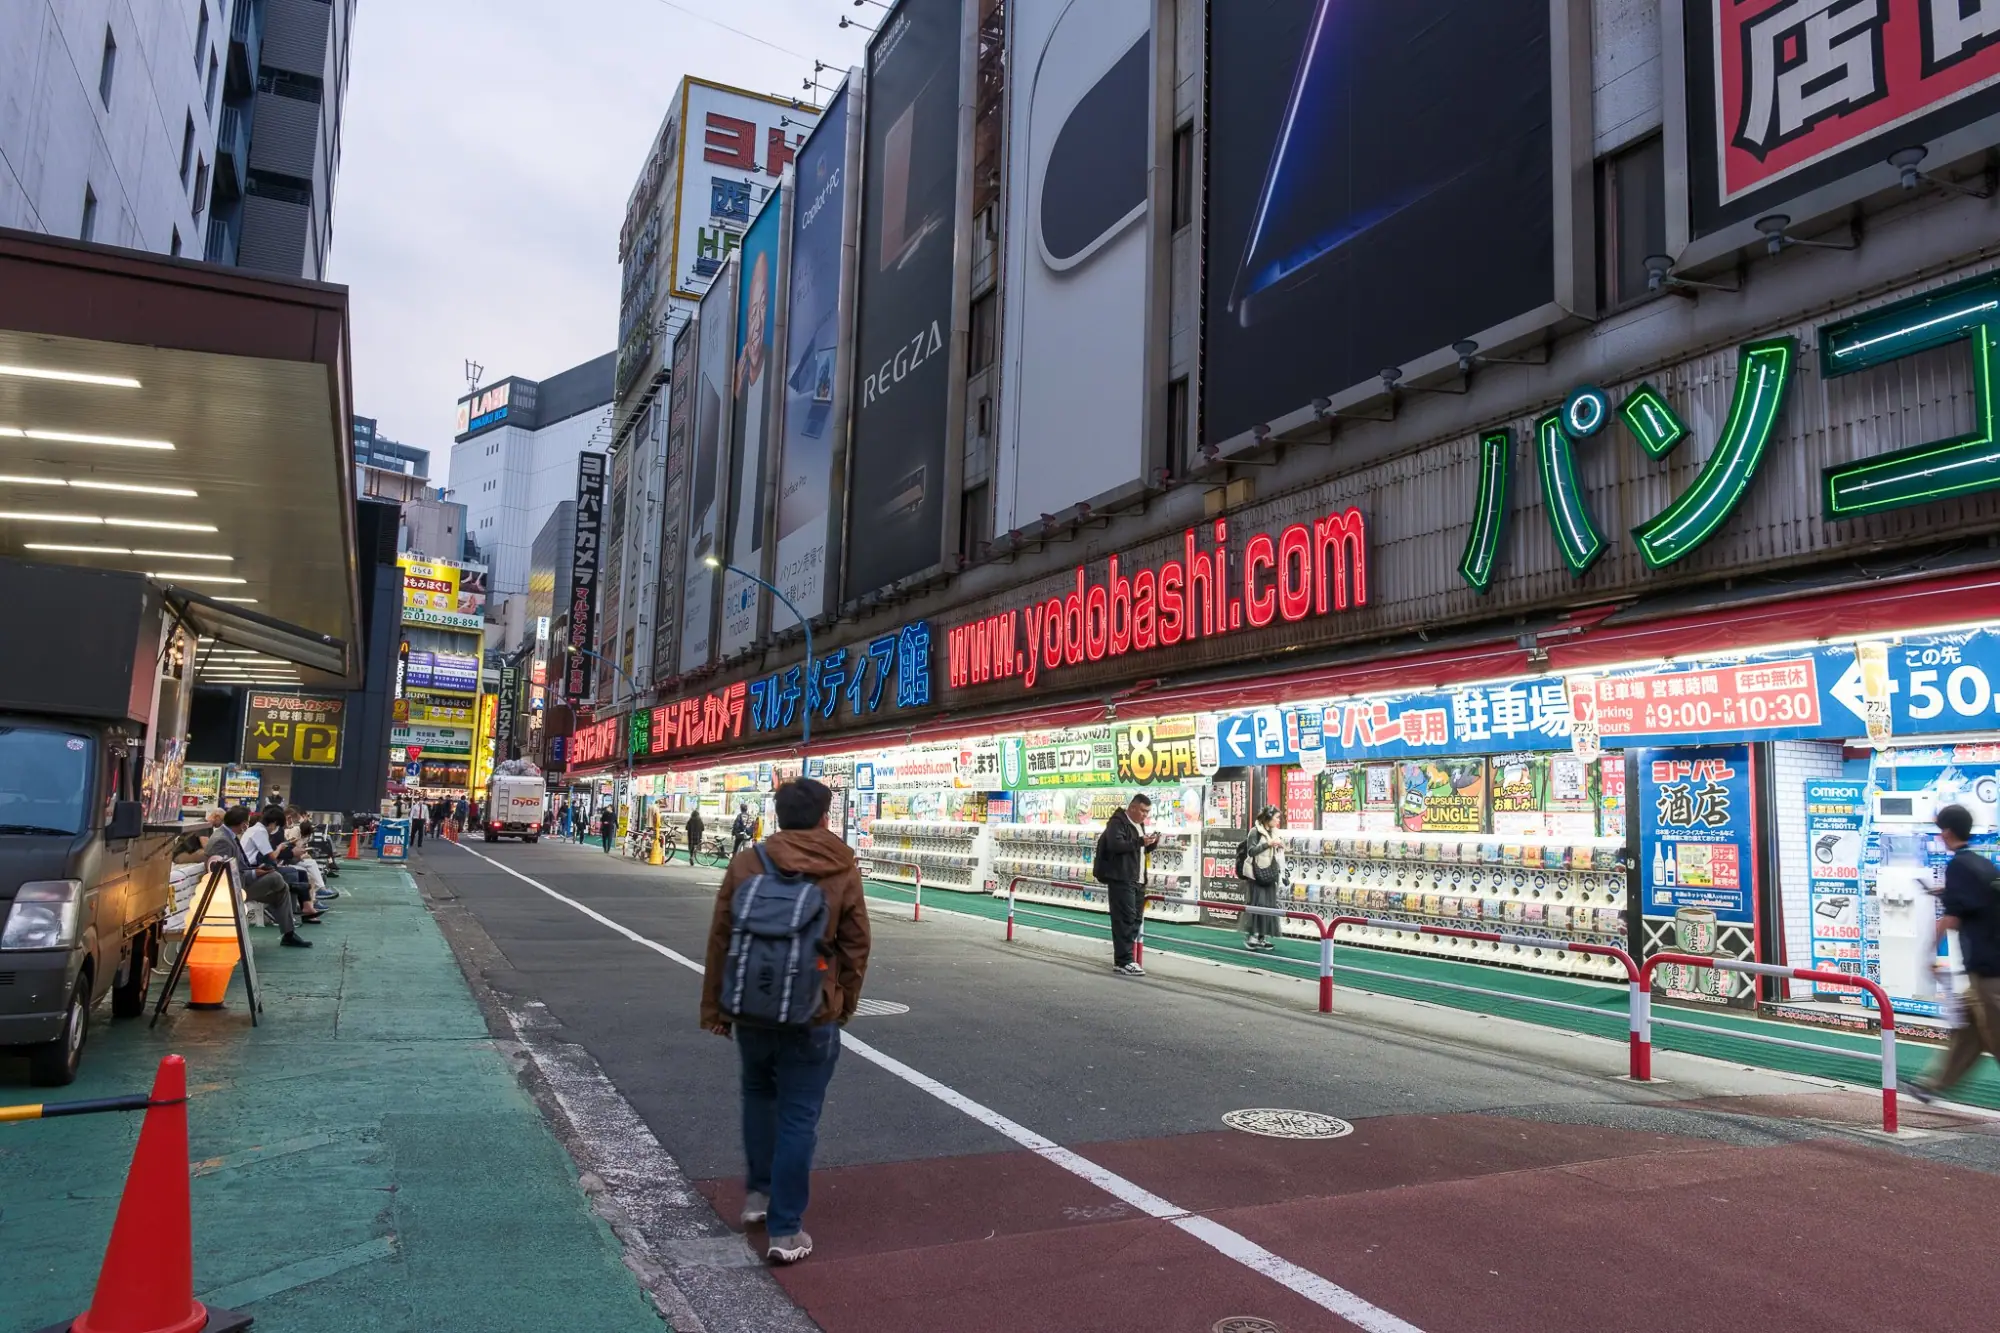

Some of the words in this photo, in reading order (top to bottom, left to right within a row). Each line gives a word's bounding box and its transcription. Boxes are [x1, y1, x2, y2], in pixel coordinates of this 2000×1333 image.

[863, 319, 942, 408] REGZA
[574, 456, 602, 584] ヨドバシカメラ
[948, 506, 1367, 688] www.yodobashi.com
[414, 612, 479, 627] 0120-298-894
[1906, 646, 1961, 667] この先
[1652, 676, 1719, 697] 営業時間
[1740, 668, 1805, 690] 年中無休
[253, 696, 342, 712] ヨドバシカメラ
[498, 668, 514, 743] ヨドバシカメラ
[1454, 684, 1571, 742] 駐車場
[1738, 695, 1812, 723] 10:30
[267, 710, 326, 722] お客様専用
[652, 680, 748, 753] ヨドバシカメラ
[253, 721, 289, 738] 入口
[302, 727, 332, 760] P
[1953, 743, 2000, 761] 生活
[1028, 751, 1057, 771] 冷蔵庫
[1060, 749, 1091, 767] エアコン
[876, 760, 952, 780] www.yodobashi.com
[1652, 759, 1735, 783] ヨドバシ
[511, 798, 540, 807] DyDo
[1294, 789, 1312, 799] 9:30
[1425, 796, 1460, 806] CAPSULE
[1462, 796, 1478, 806] TOY
[1811, 787, 1858, 798] OMRON
[1292, 809, 1314, 820] 10:00
[1422, 807, 1479, 823] JUNGLE
[1657, 783, 1731, 828] 酒店
